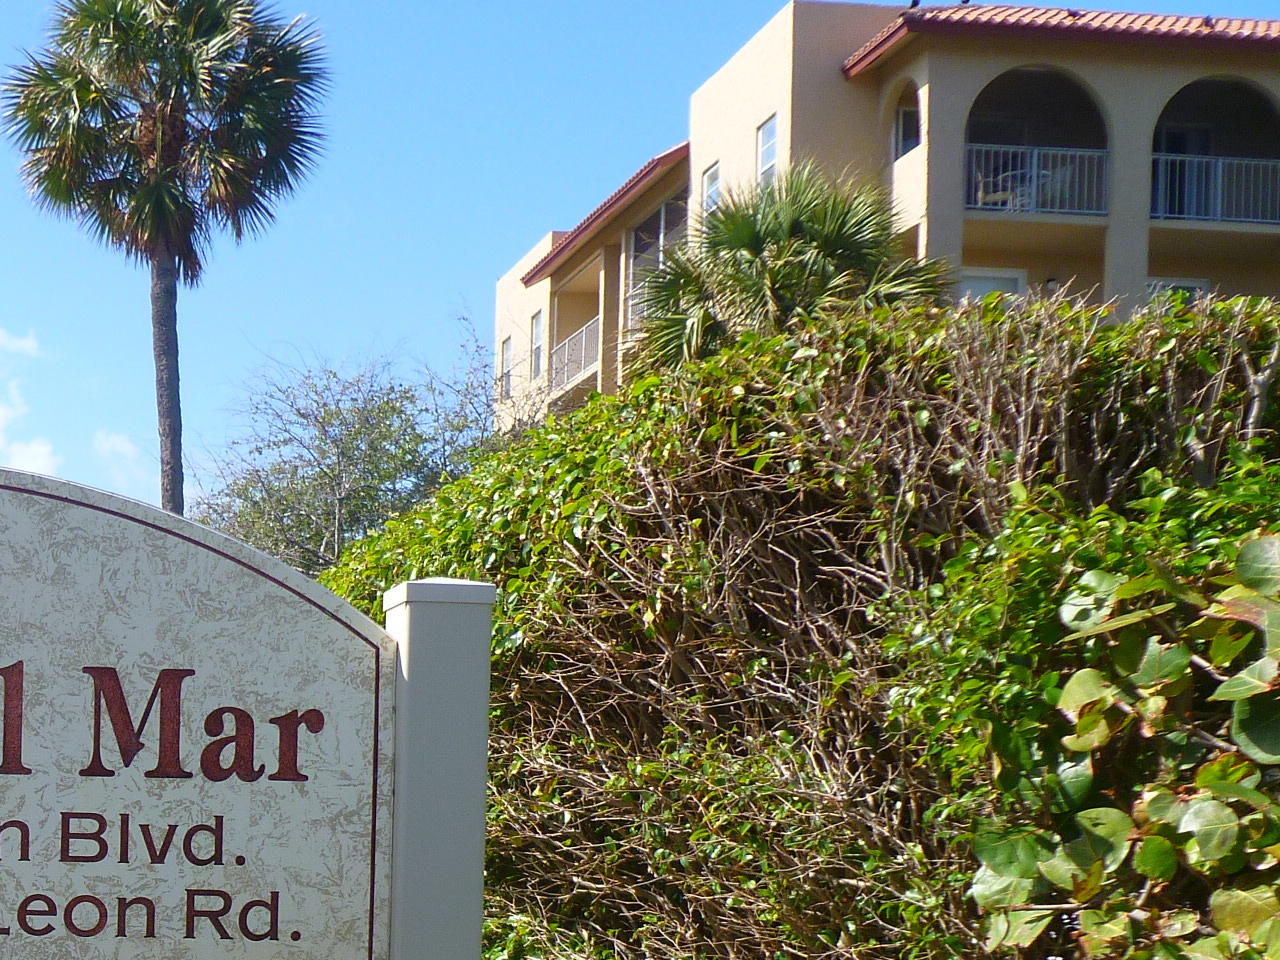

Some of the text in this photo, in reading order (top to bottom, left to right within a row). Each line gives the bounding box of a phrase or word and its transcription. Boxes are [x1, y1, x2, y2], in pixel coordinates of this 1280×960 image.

[79, 665, 325, 785] Mar
[58, 811, 247, 868] Blvd.
[184, 887, 302, 942] Rd.
